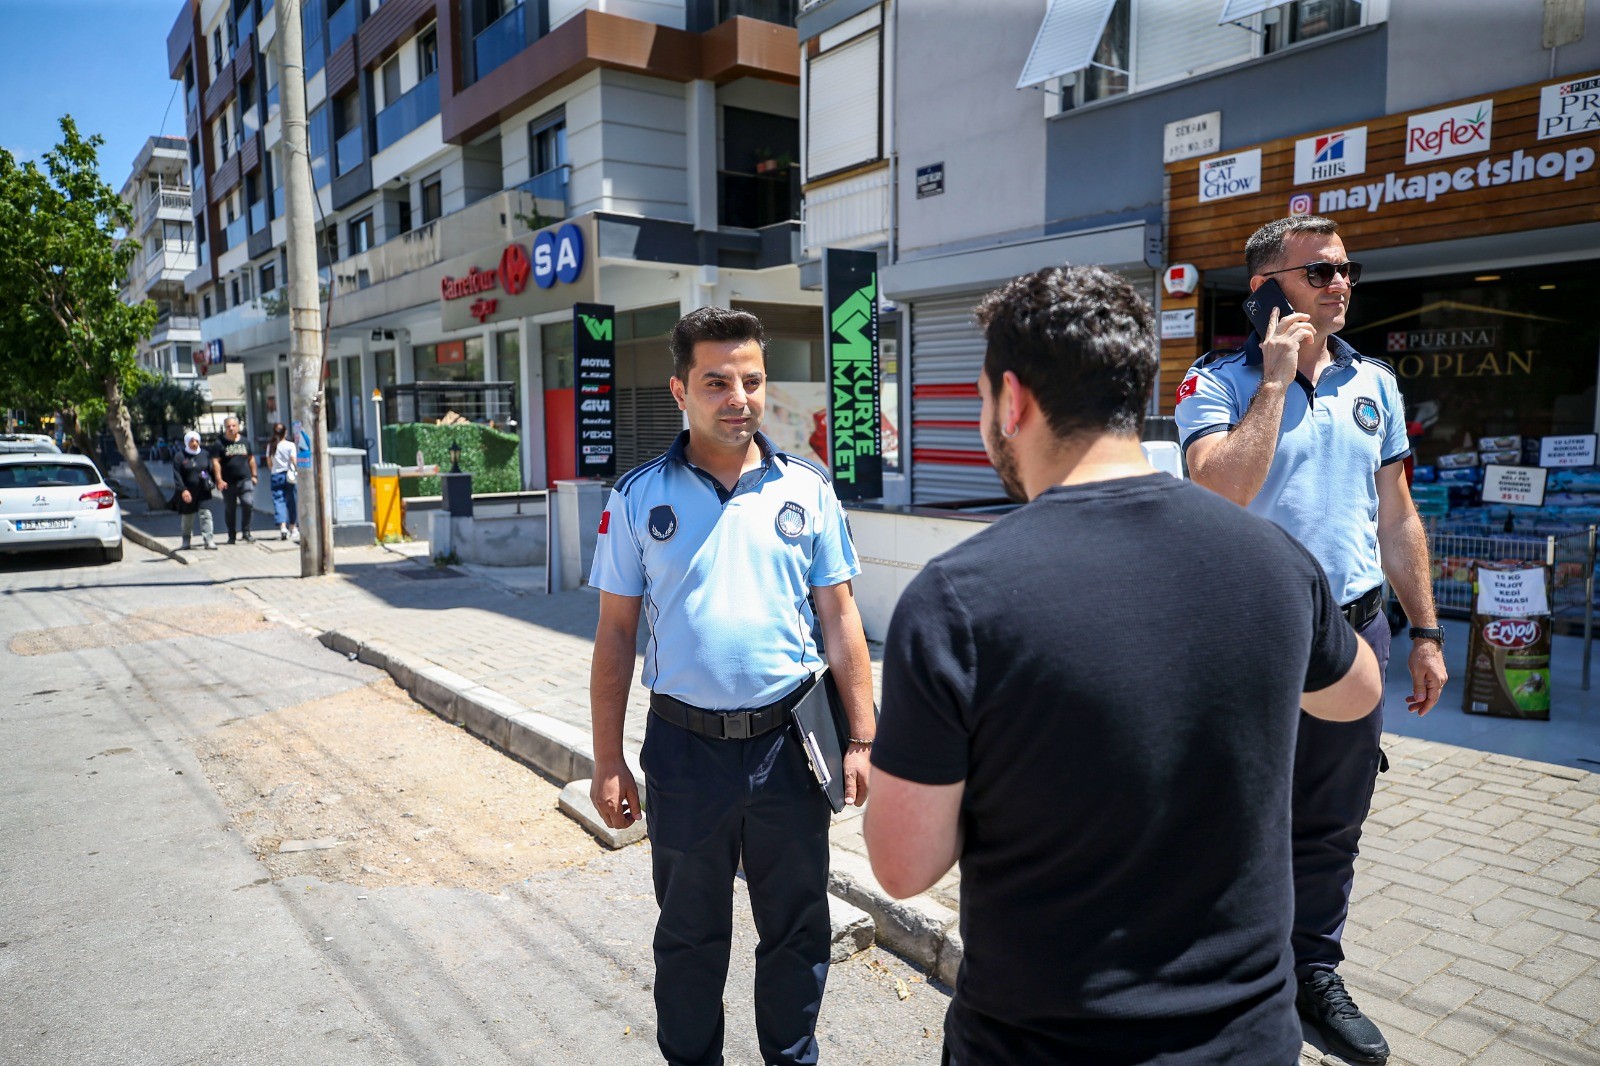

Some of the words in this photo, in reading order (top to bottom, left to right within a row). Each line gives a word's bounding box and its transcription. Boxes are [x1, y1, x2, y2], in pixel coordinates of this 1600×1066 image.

[1409, 118, 1485, 155] Reflex
[1205, 167, 1232, 183] CAT
[1205, 176, 1253, 197] CHOW
[1319, 146, 1595, 213] maykapetshop
[535, 237, 577, 276] SA
[1410, 330, 1489, 347] PURINA
[581, 358, 611, 367] MOTUL
[1432, 350, 1533, 378] PLAN
[833, 361, 855, 483] MARKET
[854, 361, 874, 456] KURYE
[1487, 620, 1537, 645] Enjoy
